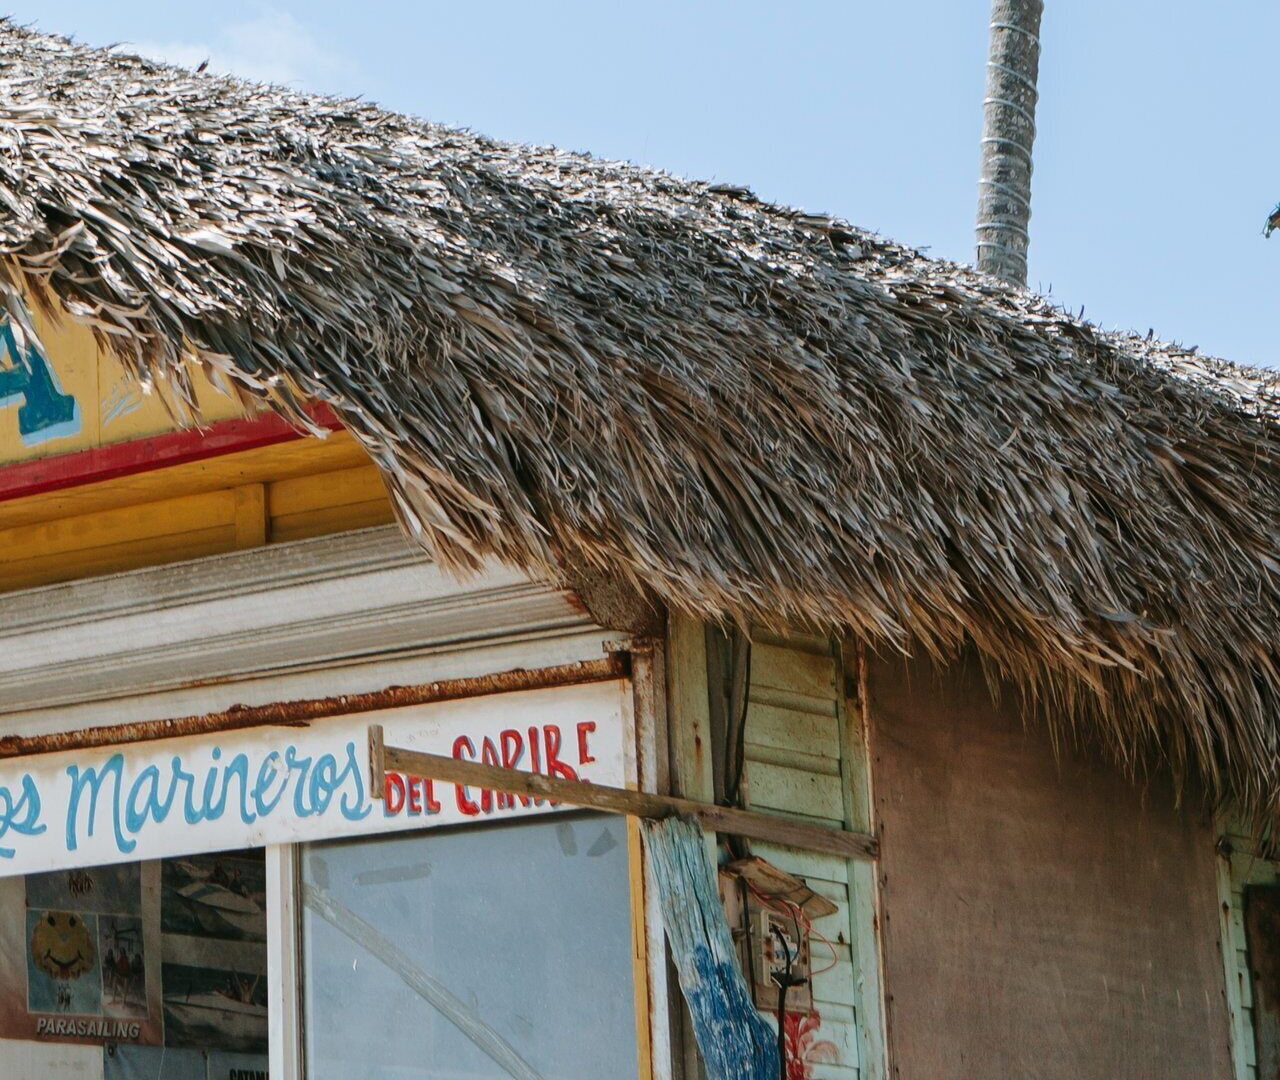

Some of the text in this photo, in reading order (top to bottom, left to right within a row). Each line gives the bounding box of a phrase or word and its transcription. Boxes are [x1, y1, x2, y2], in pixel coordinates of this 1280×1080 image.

[66, 743, 373, 854] Marineros
[384, 771, 442, 818] DEL
[451, 720, 597, 817] CARIBE
[36, 1017, 140, 1040] PARASAILING
